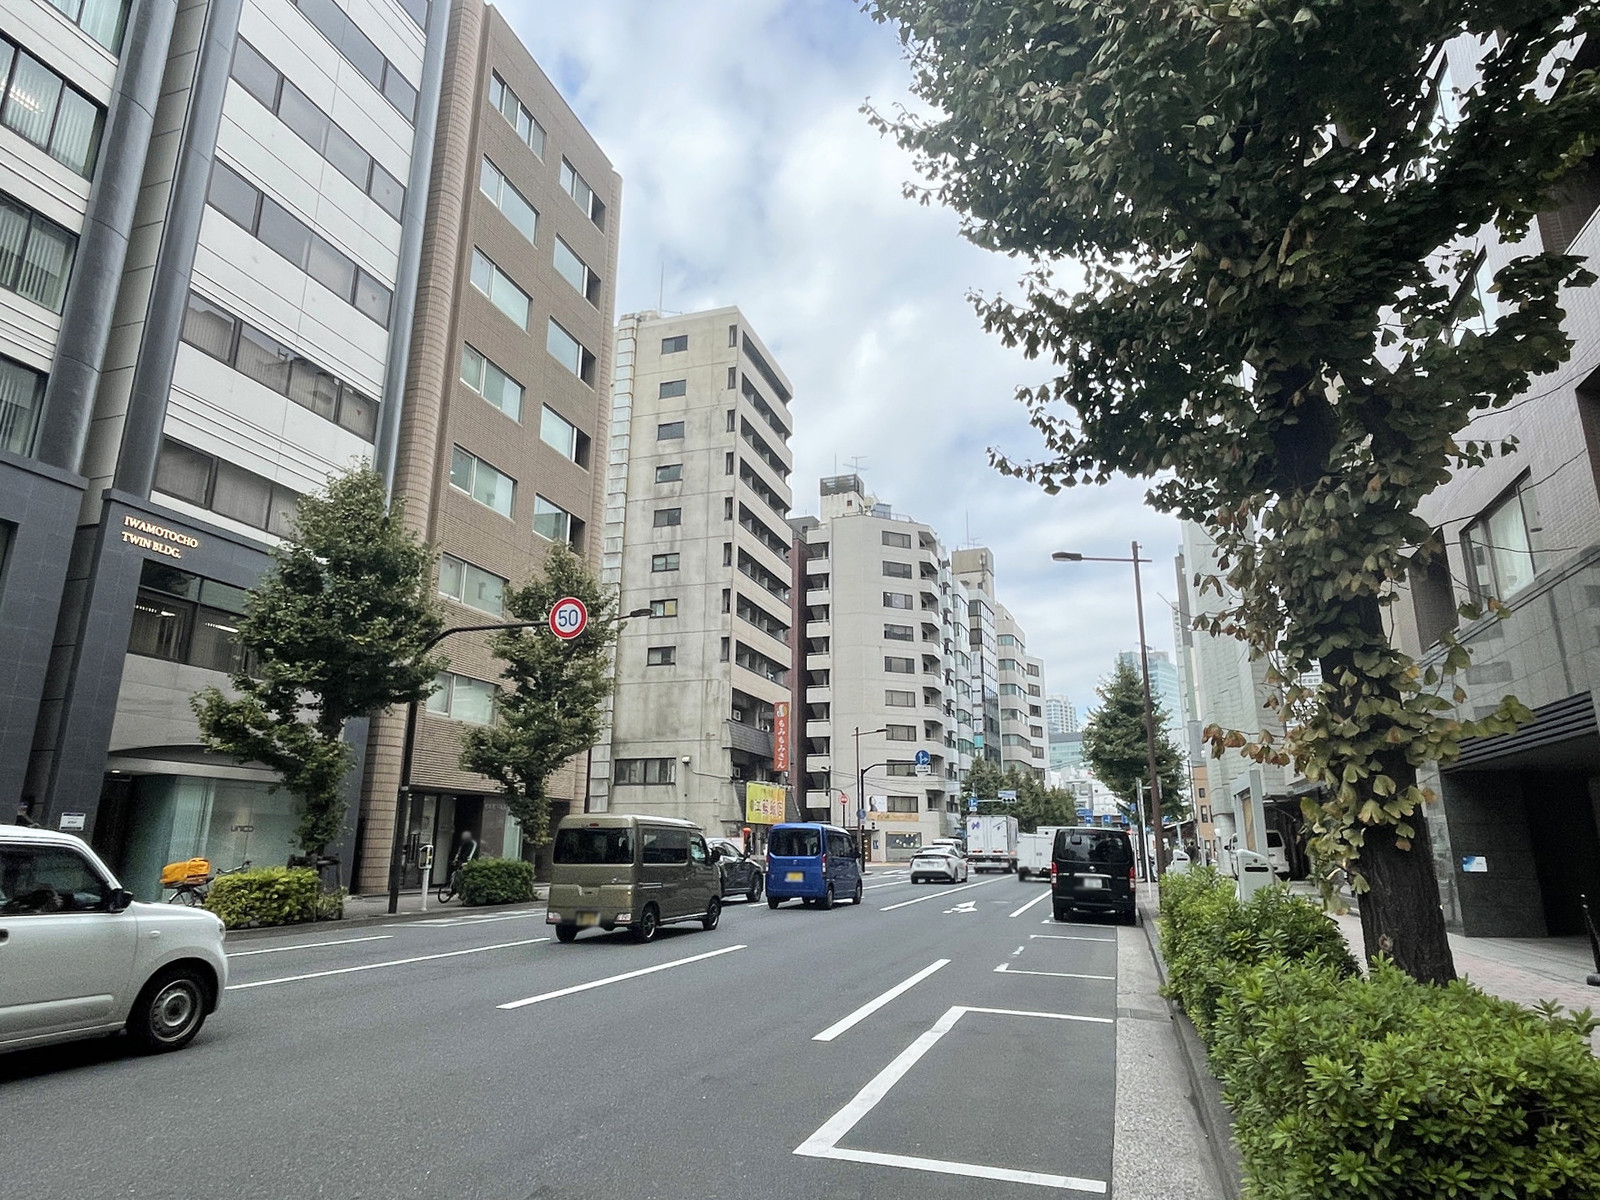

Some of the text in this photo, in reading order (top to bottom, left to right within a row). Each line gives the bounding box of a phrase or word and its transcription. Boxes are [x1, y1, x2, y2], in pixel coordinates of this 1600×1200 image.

[121, 531, 182, 559] TWIN BLDG.
[123, 515, 199, 548] IWAMOTOCHO
[558, 609, 579, 628] 50
[777, 719, 786, 769] もみもみさん
